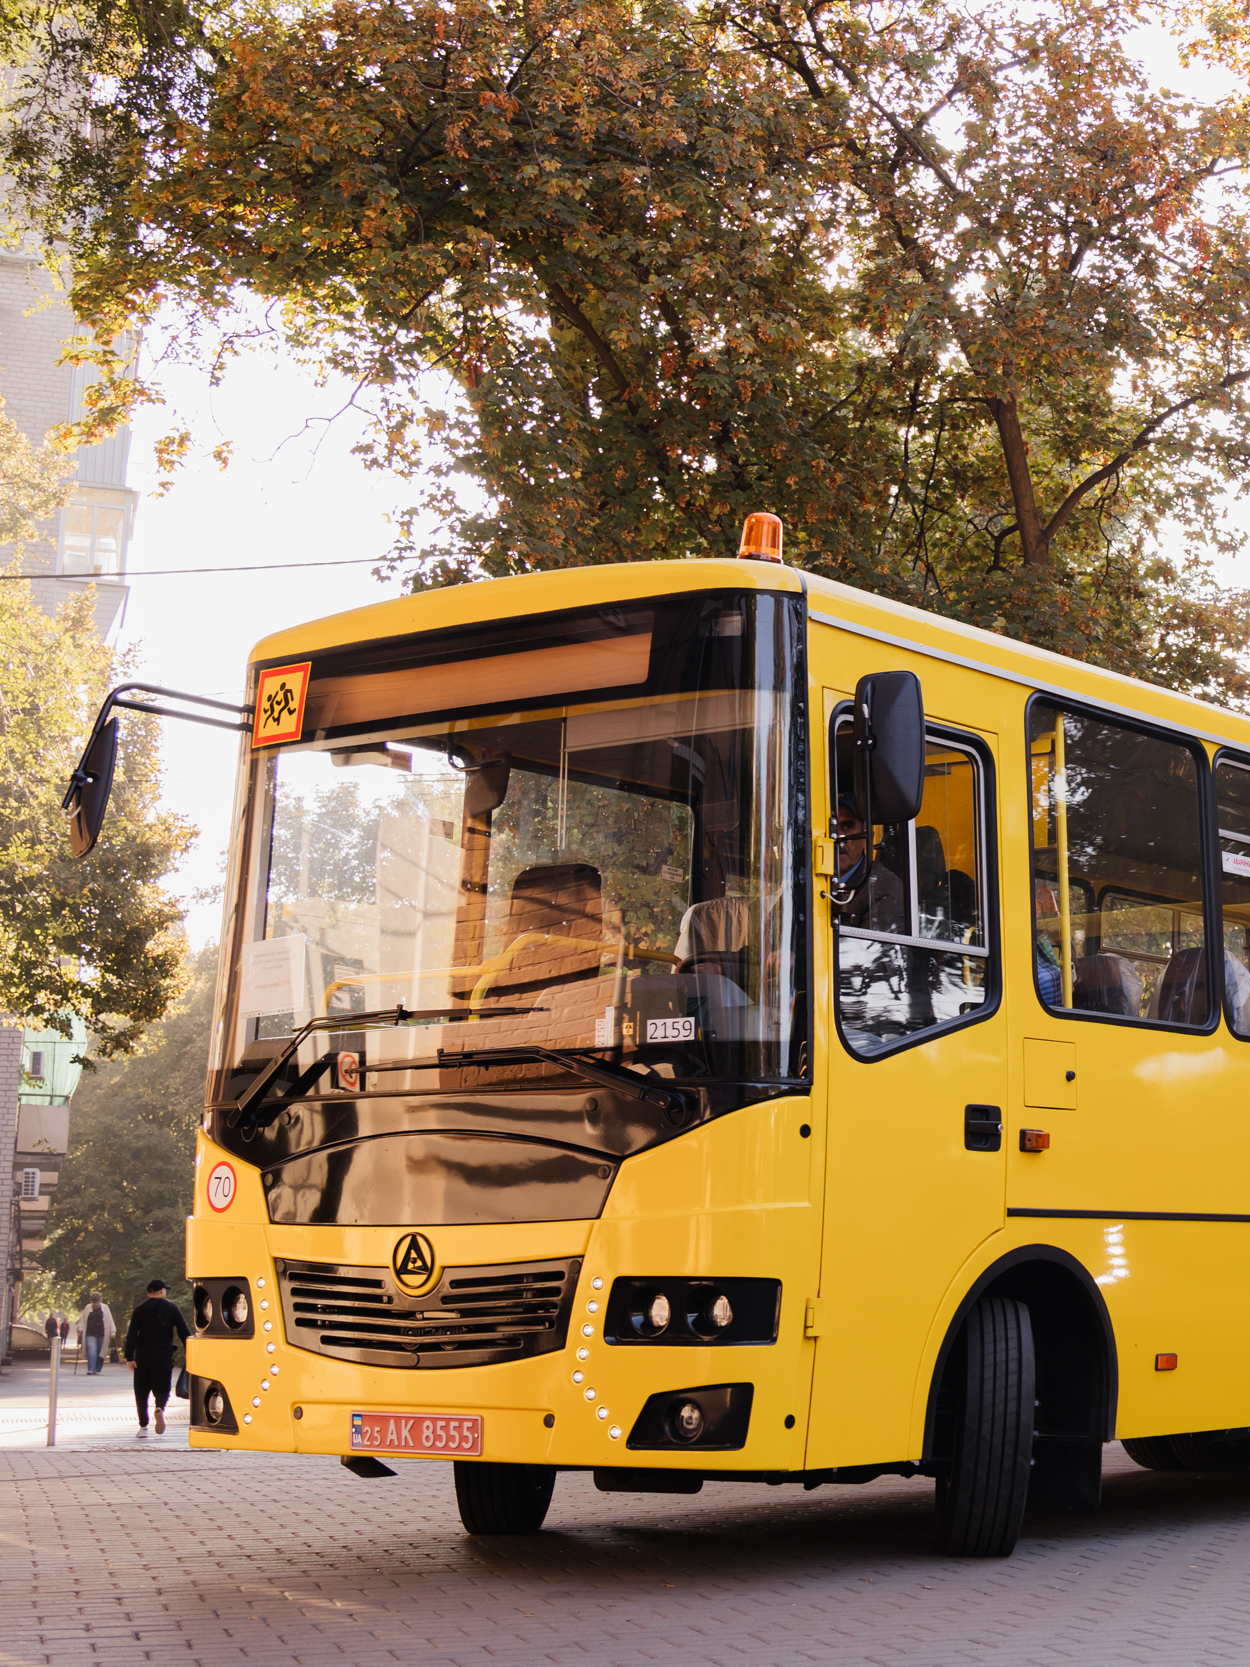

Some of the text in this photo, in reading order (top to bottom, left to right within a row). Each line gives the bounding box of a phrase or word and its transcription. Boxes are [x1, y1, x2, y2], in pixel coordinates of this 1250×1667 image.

[597, 1020, 605, 1046] 2159
[649, 1020, 693, 1040] 2159
[214, 1176, 231, 1198] 70
[352, 1433, 362, 1444] UA
[363, 1426, 382, 1446] 25
[422, 1420, 474, 1450] 8555
